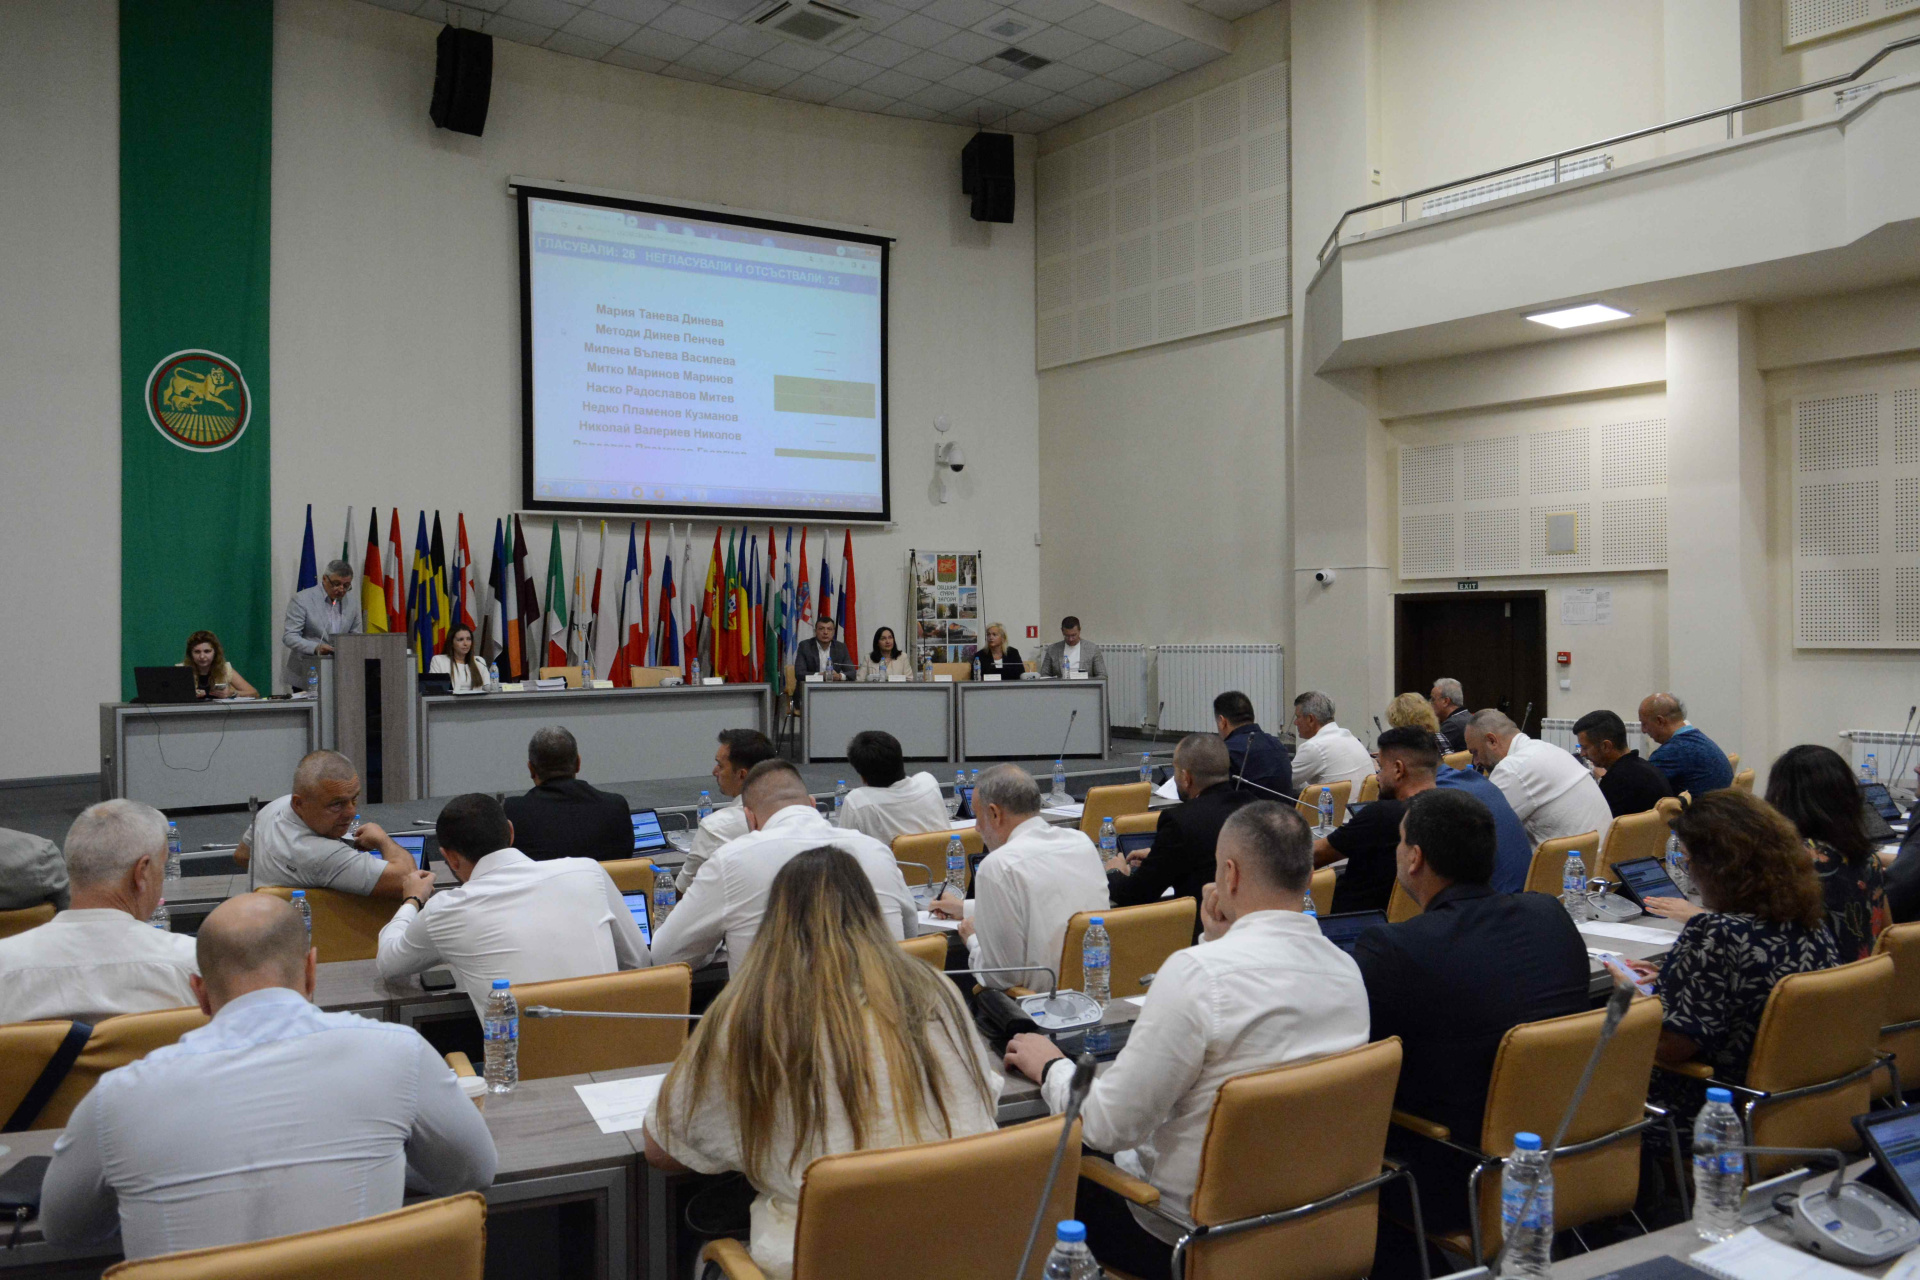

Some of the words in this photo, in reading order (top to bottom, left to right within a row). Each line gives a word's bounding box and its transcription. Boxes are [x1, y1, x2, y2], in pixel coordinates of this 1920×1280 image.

[538, 237, 619, 257] ГЛАСУВАЛИ:
[645, 252, 732, 272] НЕГЛАСУВАЛИ
[734, 262, 743, 273] И
[745, 264, 825, 284] ОТСЪСТВАЛИ:
[828, 275, 840, 286] 25
[596, 303, 635, 318] Мария
[638, 308, 679, 322] Танева
[682, 313, 724, 328] Динева
[595, 323, 640, 338] Методи
[643, 328, 680, 342] Динев
[683, 332, 725, 347] Пенчев
[584, 342, 630, 356] Милена
[633, 346, 678, 361] Вълева
[681, 351, 736, 366] Василева
[586, 361, 624, 375] Митко
[627, 365, 680, 380] Маринов
[683, 370, 734, 385] Маринов
[586, 381, 623, 395] Наско
[625, 385, 696, 400] Радославов
[699, 391, 735, 404] Митев
[582, 401, 619, 414] Недко
[622, 404, 682, 418] Пламенов
[685, 408, 739, 422] Кузманов
[578, 420, 630, 433] Николай
[634, 423, 691, 438] Валериев
[693, 428, 742, 441] Николов
